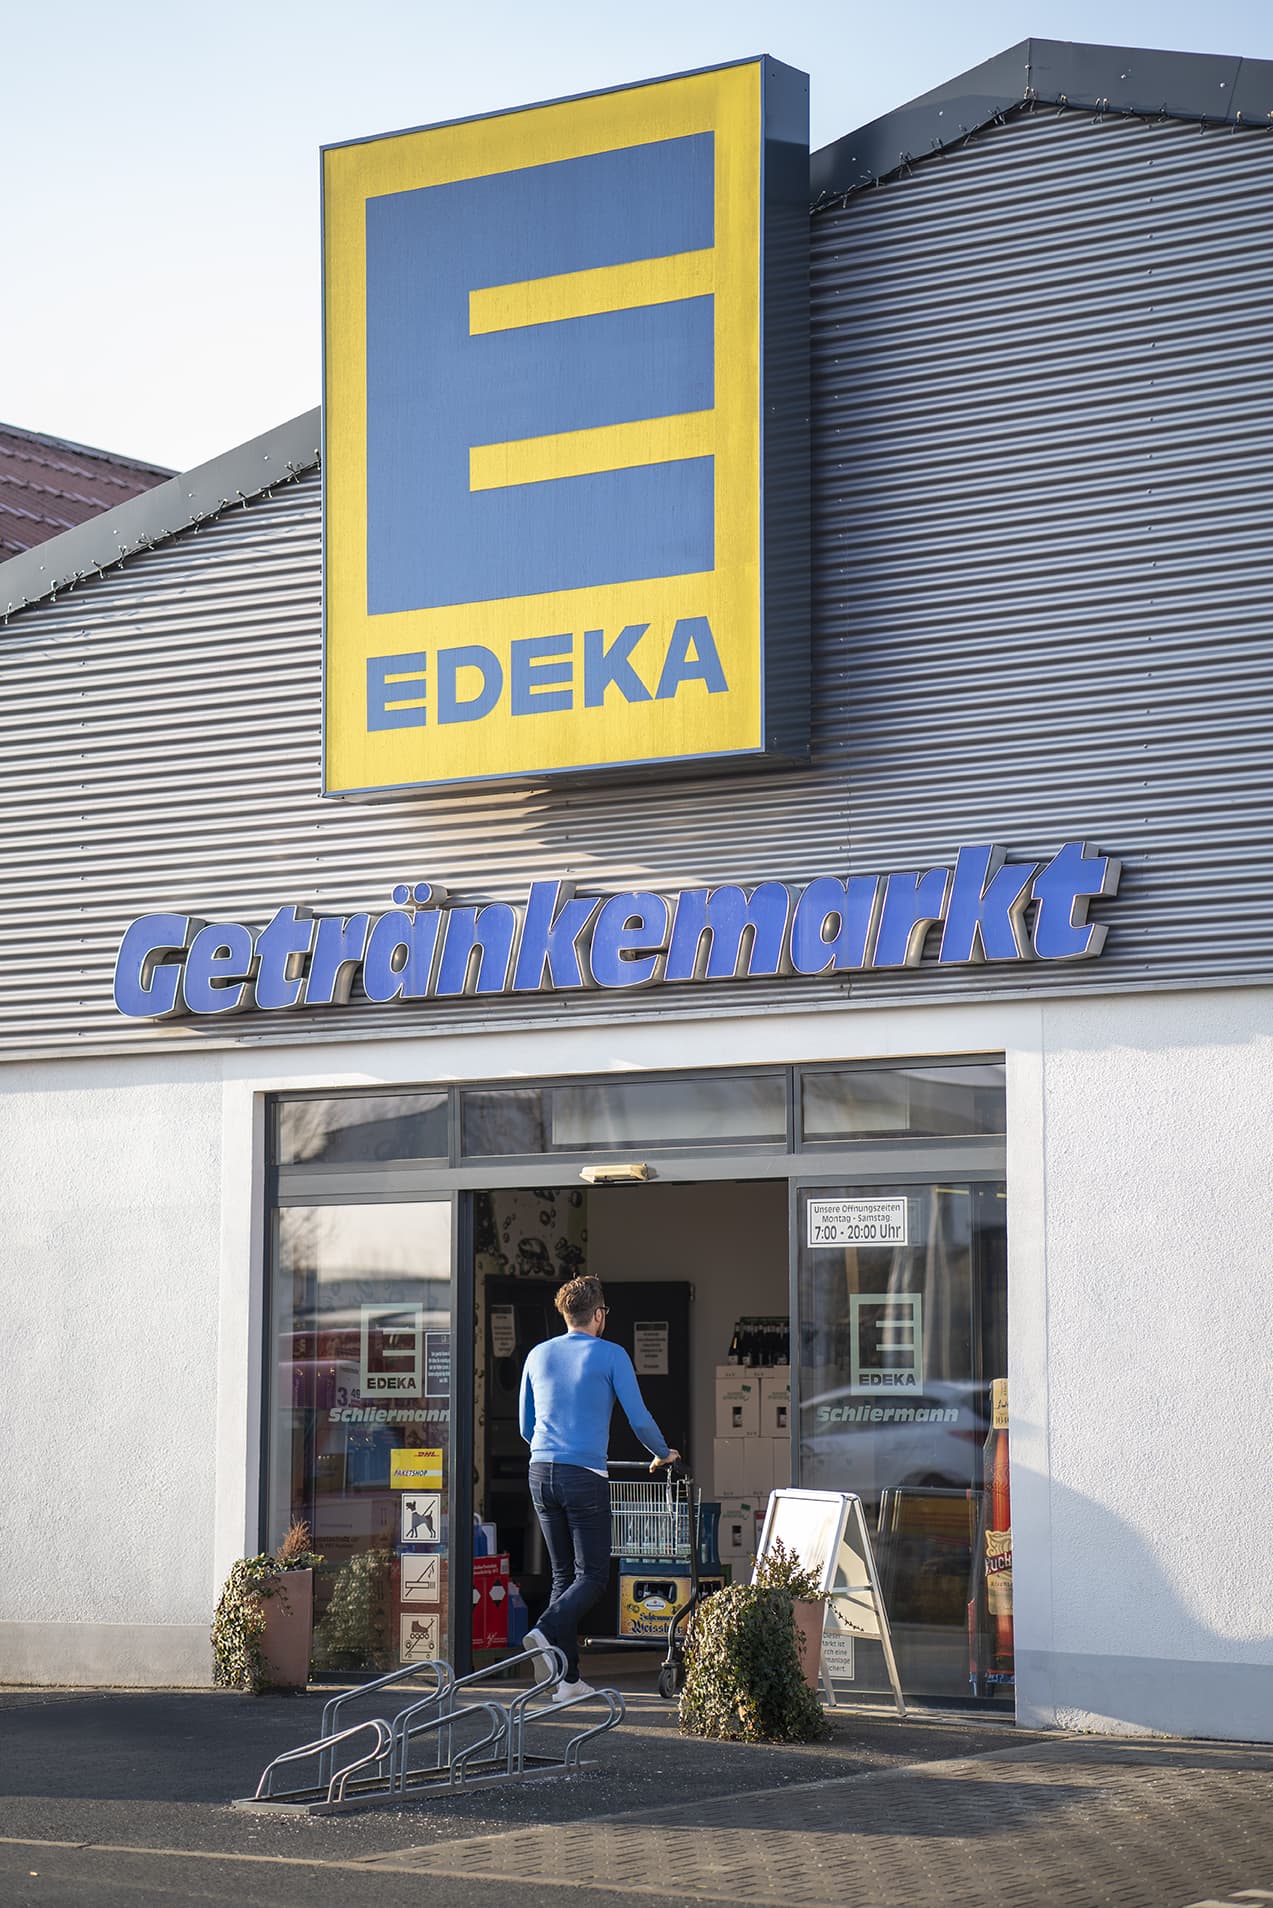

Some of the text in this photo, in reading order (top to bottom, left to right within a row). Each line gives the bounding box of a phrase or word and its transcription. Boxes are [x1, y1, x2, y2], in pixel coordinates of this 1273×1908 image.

[366, 615, 729, 733] EDEKA
[113, 840, 1119, 1020] Getränkemarkt
[814, 1204, 901, 1214] Unsere Öffnungszeiten
[822, 1215, 851, 1223] Montag
[814, 1226, 837, 1240] 7:00
[847, 1224, 876, 1239] 20:00
[879, 1224, 901, 1239] Uhr
[367, 1377, 417, 1389] EDEKA
[859, 1373, 916, 1386] EDEKA
[816, 1405, 959, 1422] Schliermann
